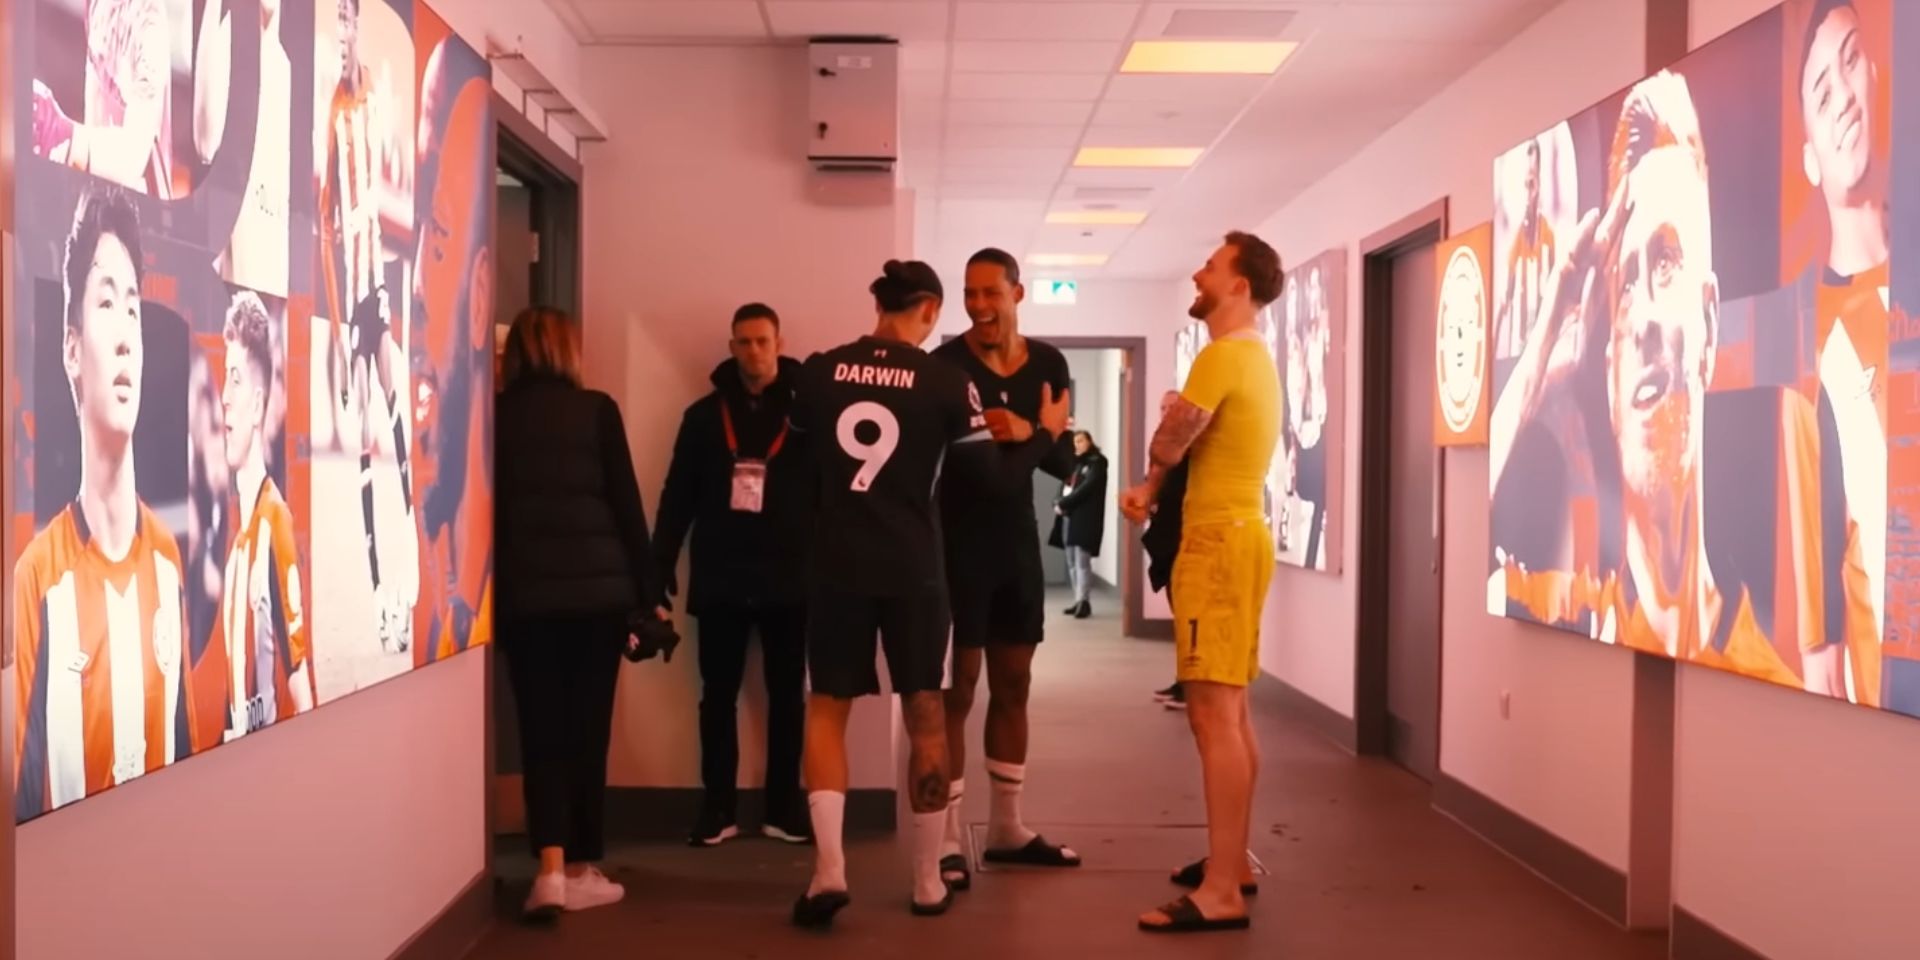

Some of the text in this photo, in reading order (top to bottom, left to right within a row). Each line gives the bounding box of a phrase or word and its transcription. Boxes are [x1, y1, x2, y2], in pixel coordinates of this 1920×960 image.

[834, 363, 915, 389] DARWIN
[836, 401, 900, 492] 9
[1188, 618, 1199, 651] 1
